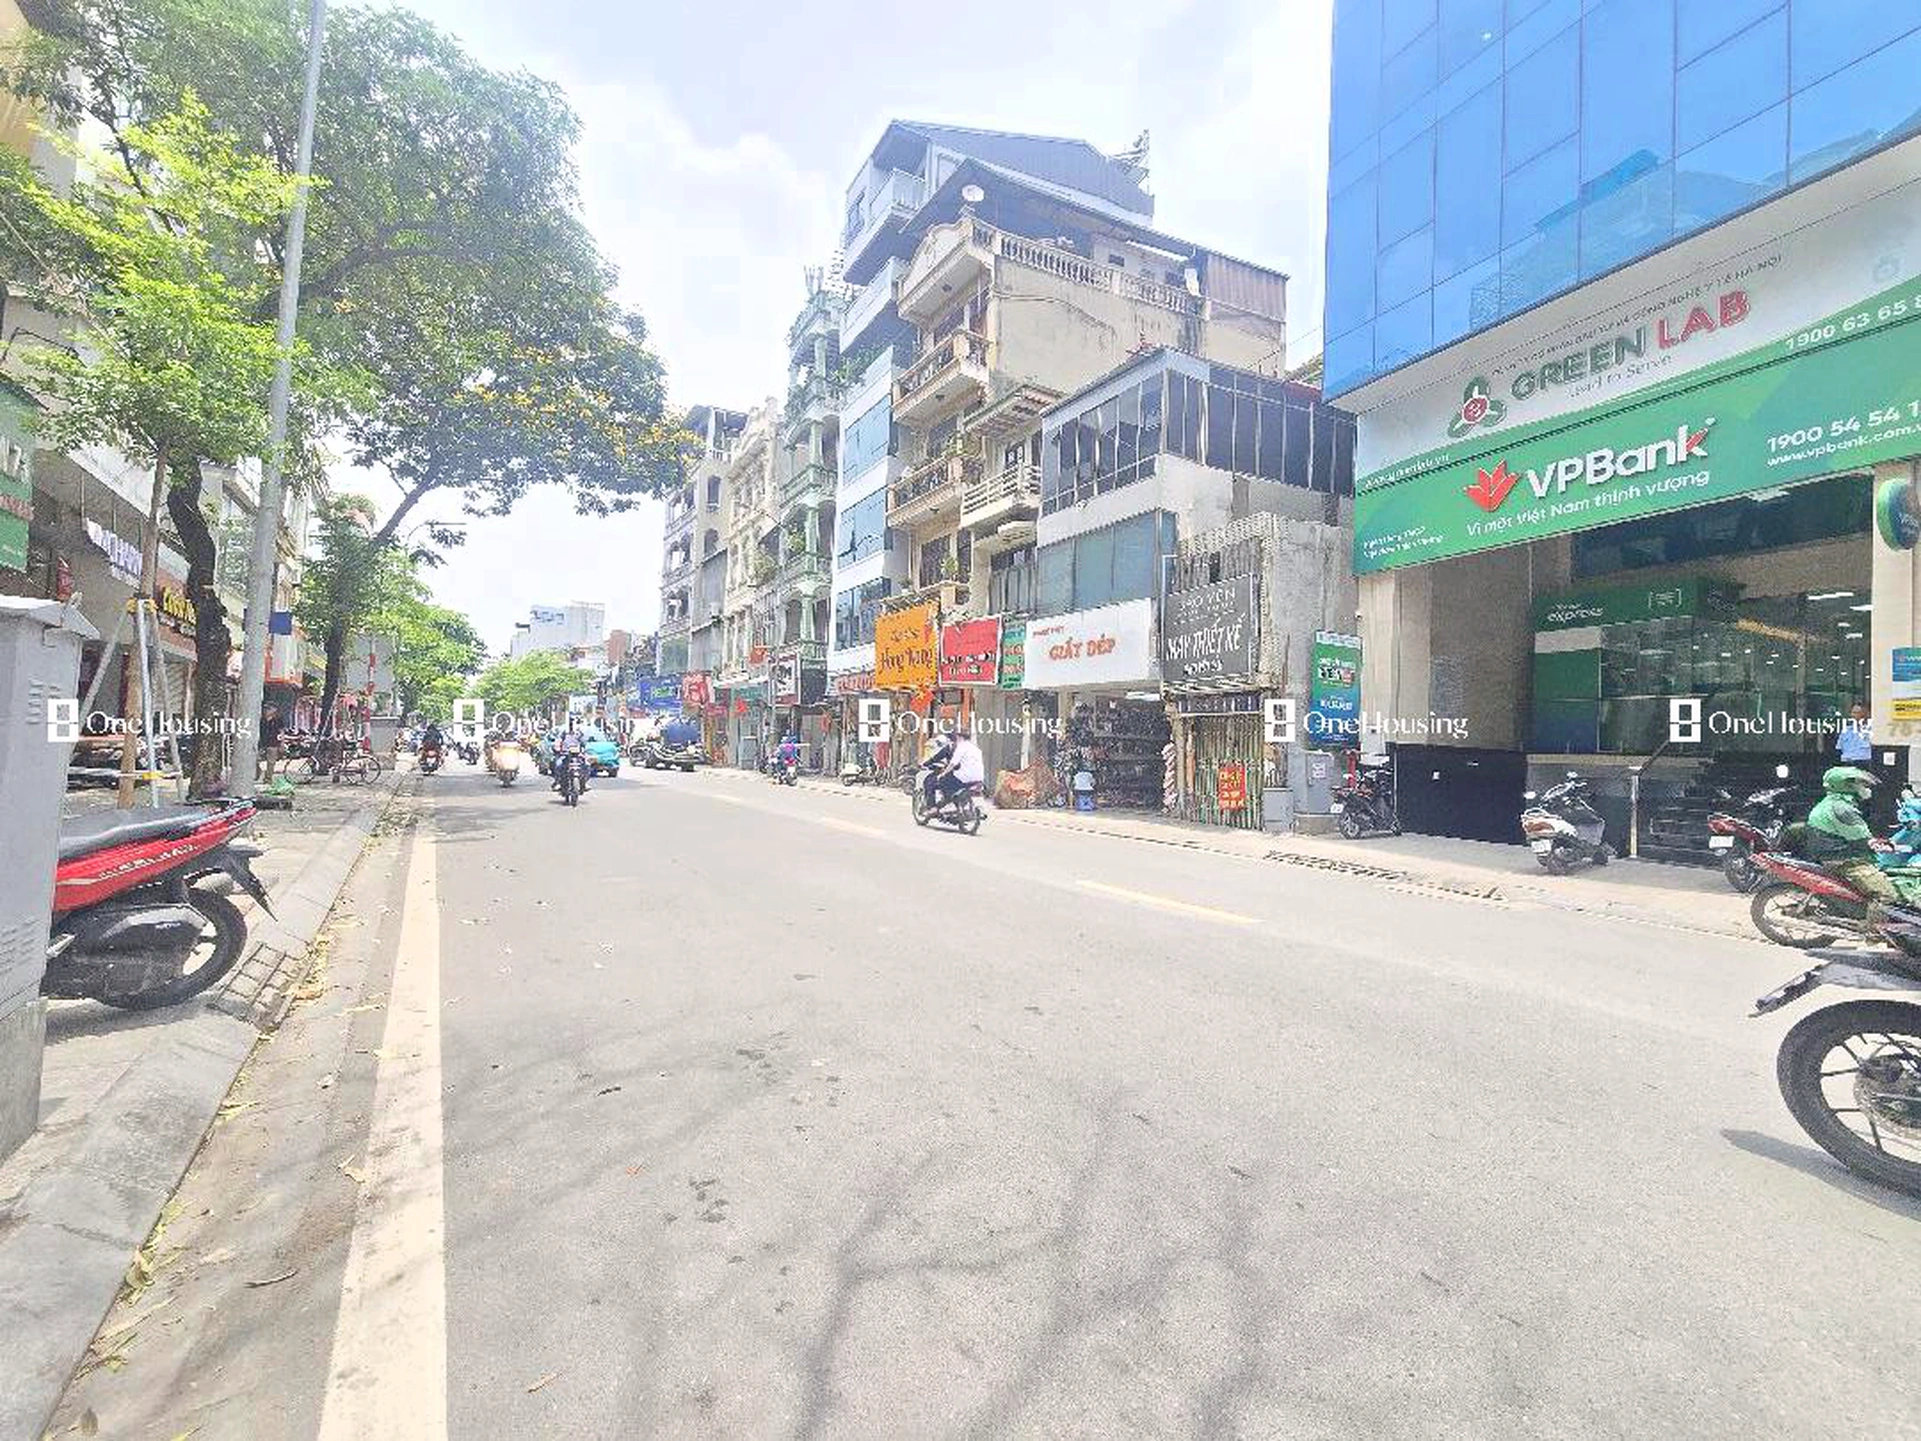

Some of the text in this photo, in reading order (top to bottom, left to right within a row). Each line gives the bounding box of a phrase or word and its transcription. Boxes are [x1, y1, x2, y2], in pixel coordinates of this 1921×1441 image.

[1511, 325, 1647, 401] GREEN
[1656, 289, 1752, 351] LAB
[1785, 324, 1837, 350] 1900
[1841, 311, 1871, 332] 63
[1877, 299, 1908, 321] 65
[1766, 425, 1823, 453] 1900
[1829, 415, 1862, 437] 54
[1867, 406, 1901, 427] 54
[1526, 424, 1710, 499] VPBank
[1550, 498, 1590, 517] Nam
